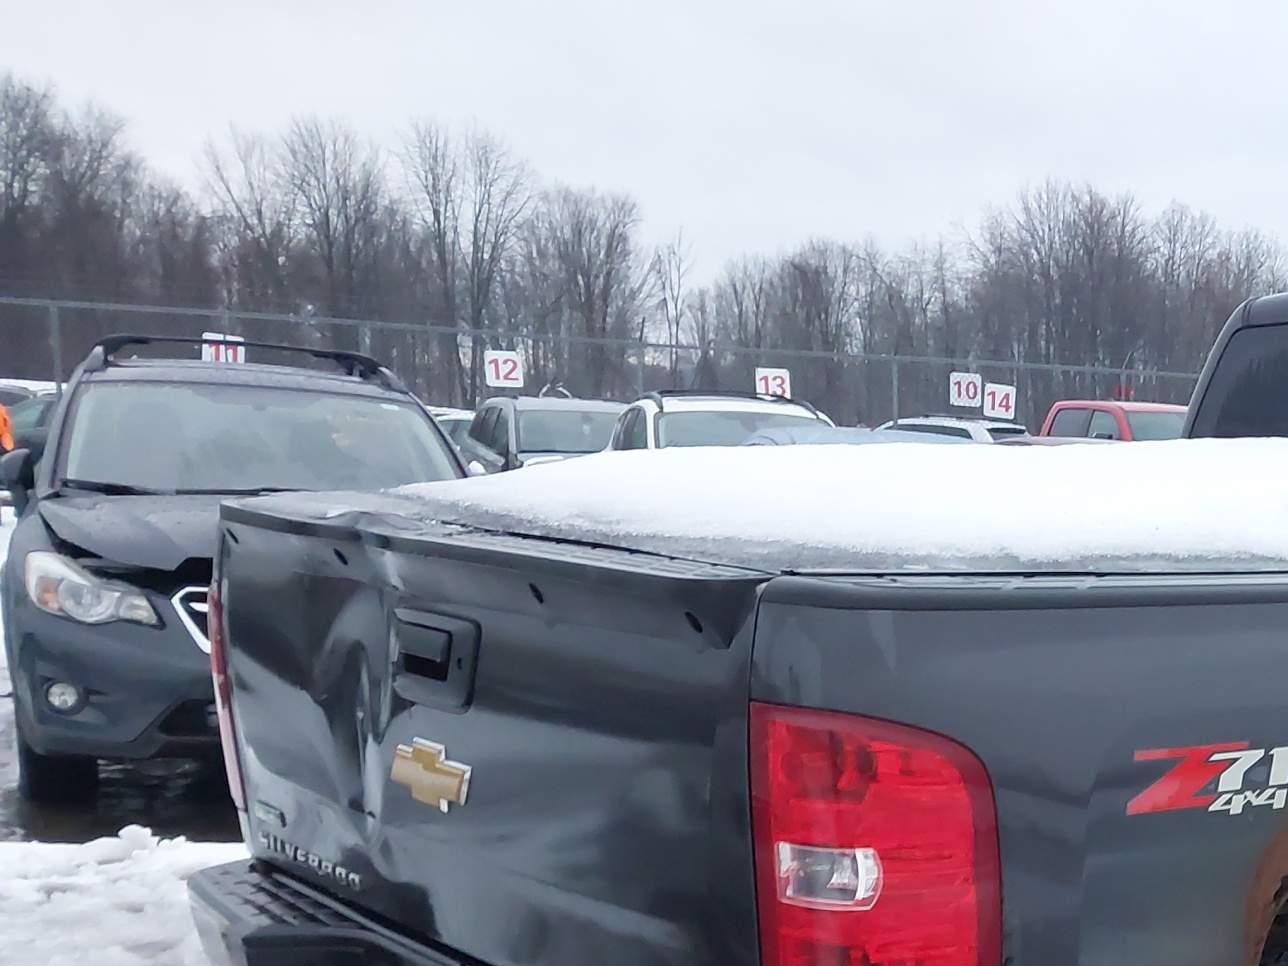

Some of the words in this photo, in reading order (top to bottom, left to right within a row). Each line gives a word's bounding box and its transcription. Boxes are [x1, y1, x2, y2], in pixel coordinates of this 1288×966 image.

[208, 341, 238, 362] 11
[488, 358, 519, 380] 12
[759, 375, 786, 397] 13
[954, 380, 978, 400] 10
[987, 390, 1012, 413] 14
